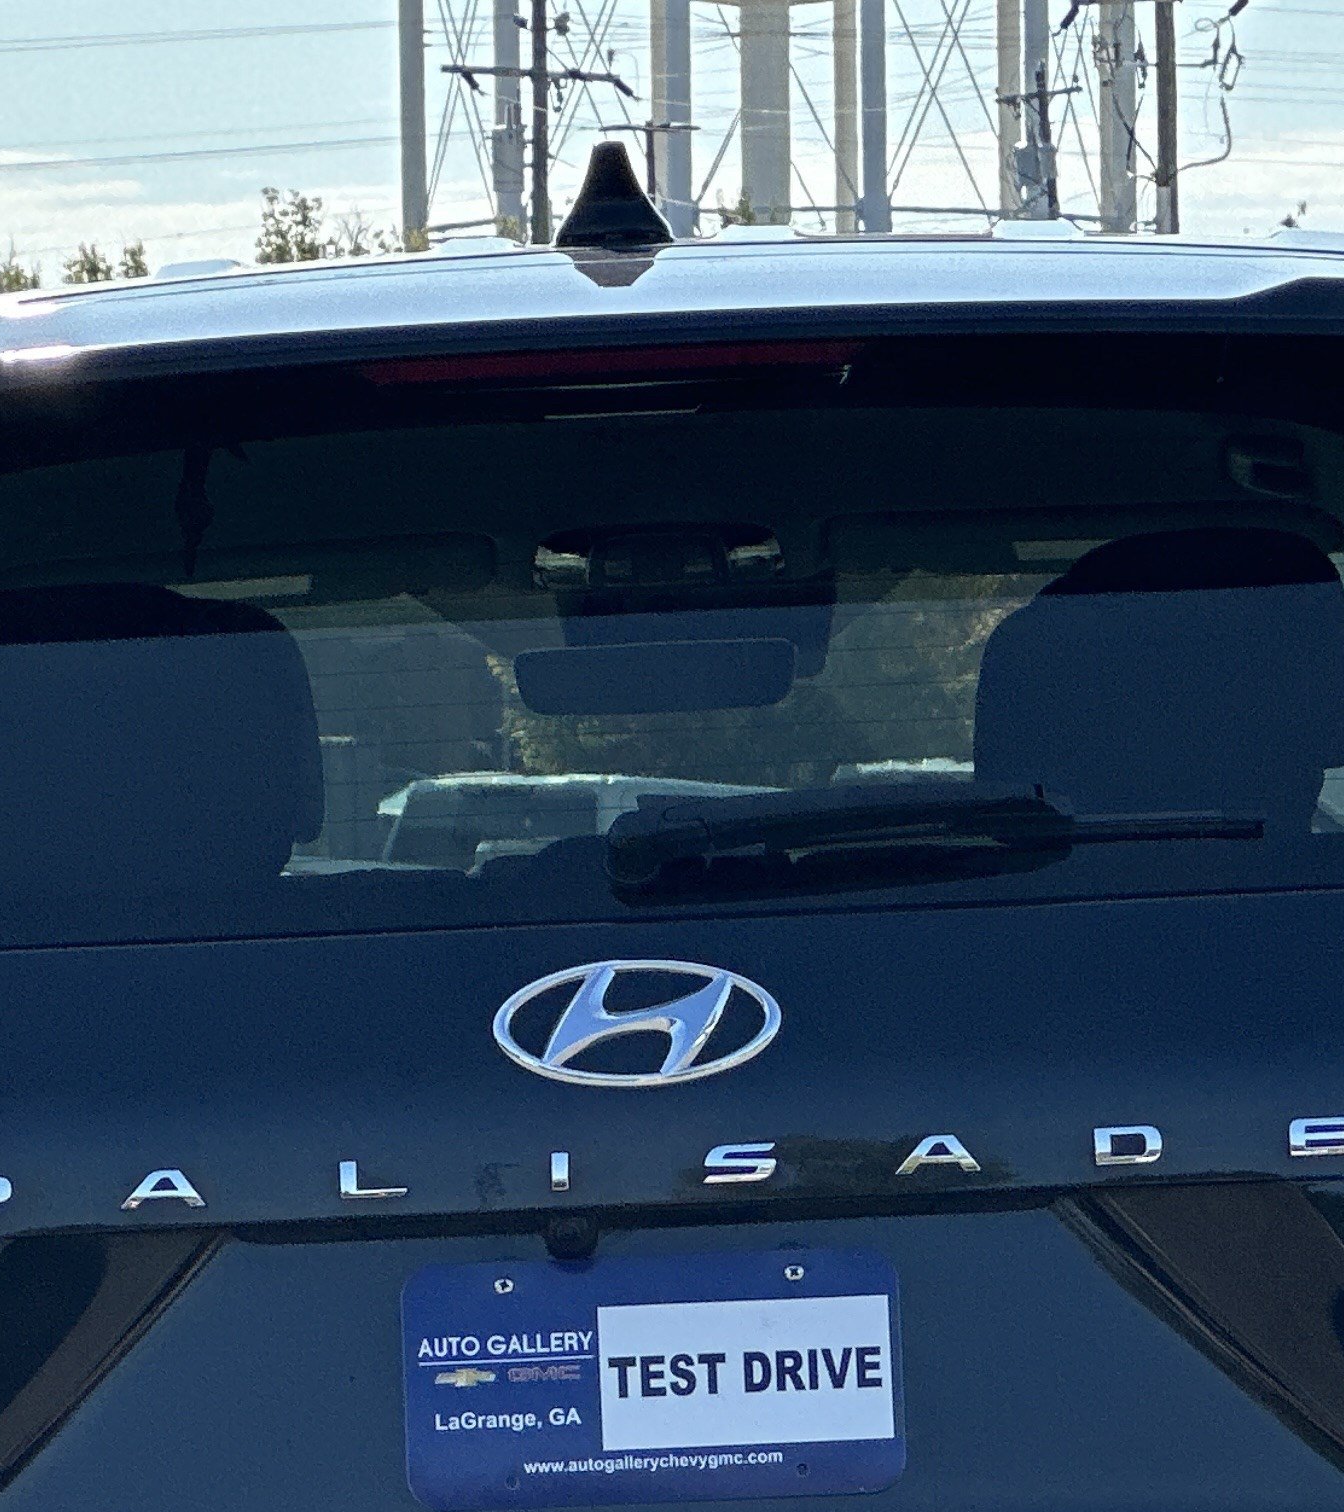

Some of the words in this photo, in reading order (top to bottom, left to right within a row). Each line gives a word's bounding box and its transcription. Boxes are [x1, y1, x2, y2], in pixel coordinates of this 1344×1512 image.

[418, 1336, 480, 1358] AUTO
[486, 1331, 593, 1355] GALLERY
[508, 1365, 581, 1382] GMC
[608, 1353, 725, 1398] TEST
[743, 1346, 883, 1393] DRIVE
[434, 1411, 543, 1432] LaGrange,
[549, 1407, 582, 1426] GA
[524, 1450, 783, 1474] www.autogallerychevygmc.com
